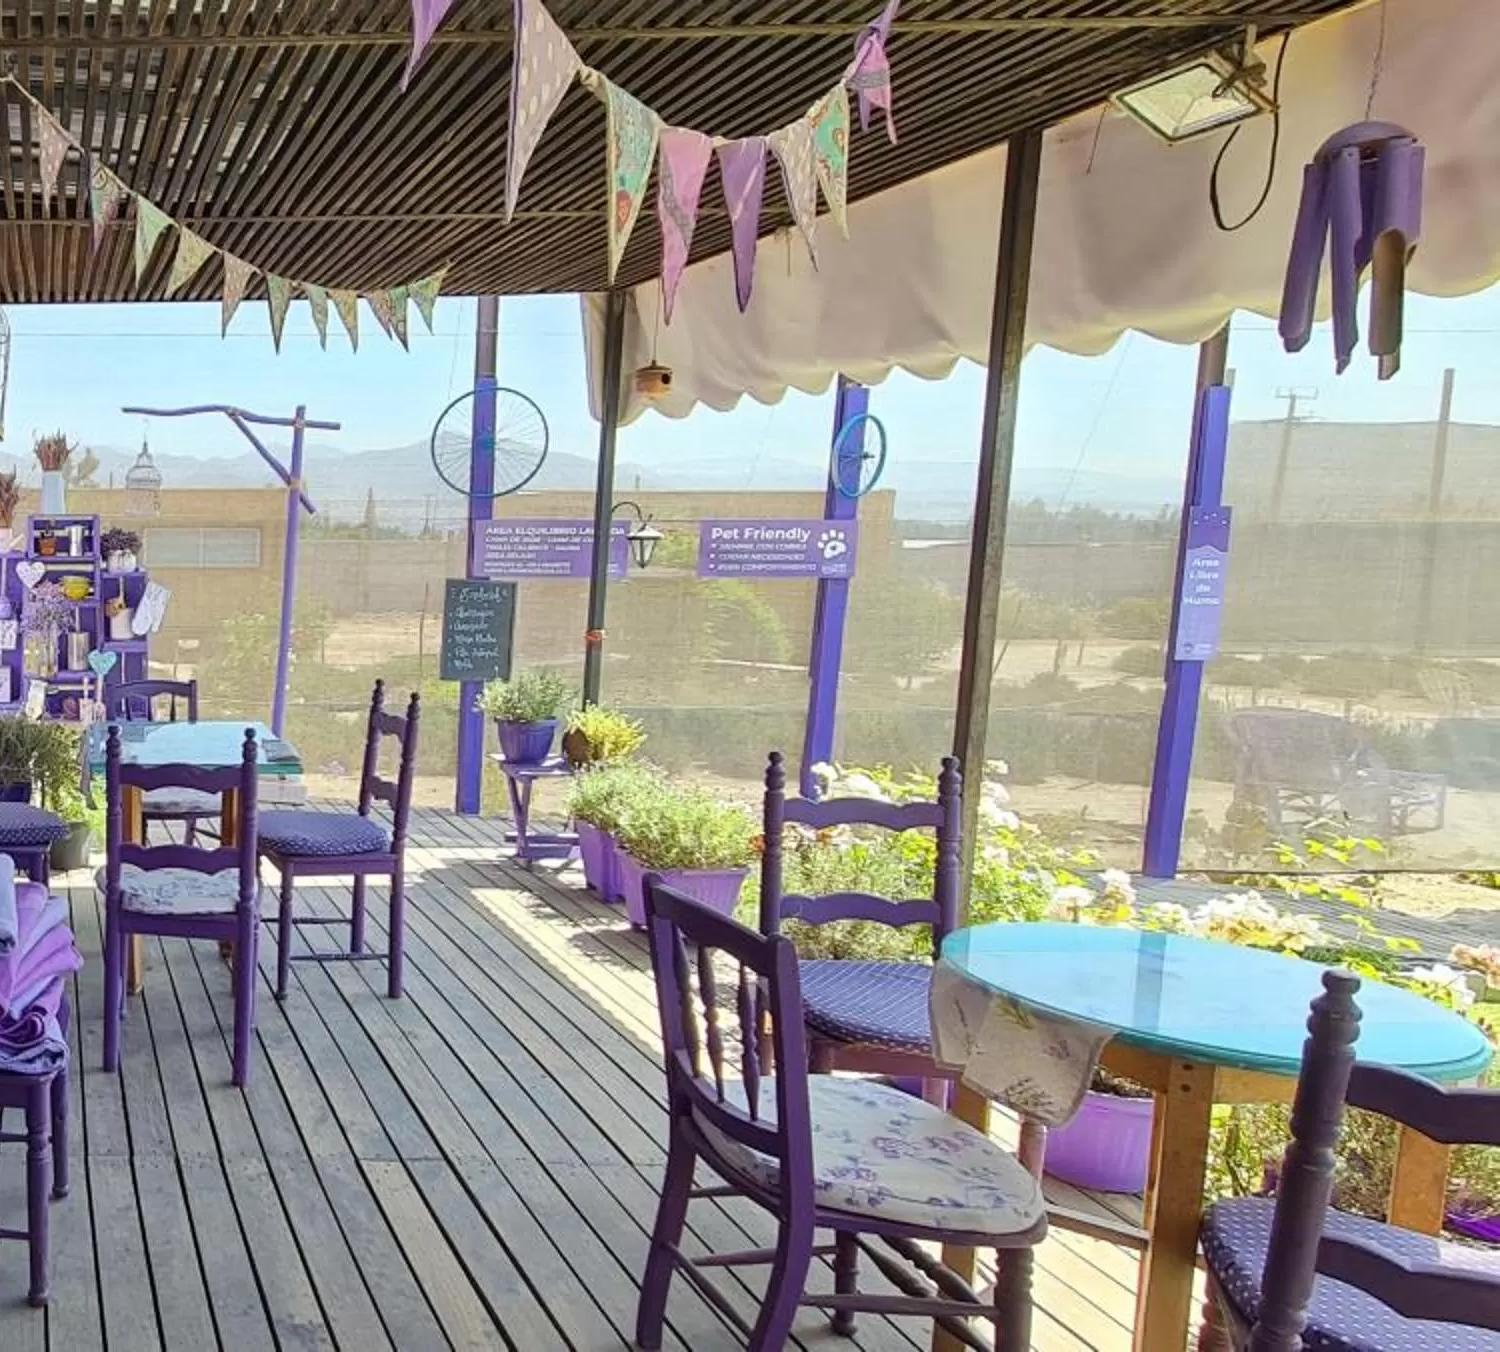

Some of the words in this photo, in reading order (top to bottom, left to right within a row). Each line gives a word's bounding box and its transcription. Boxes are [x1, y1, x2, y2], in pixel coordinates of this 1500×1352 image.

[711, 527, 741, 540] Pet
[744, 527, 812, 542] Friendly
[1196, 584, 1211, 593] de
